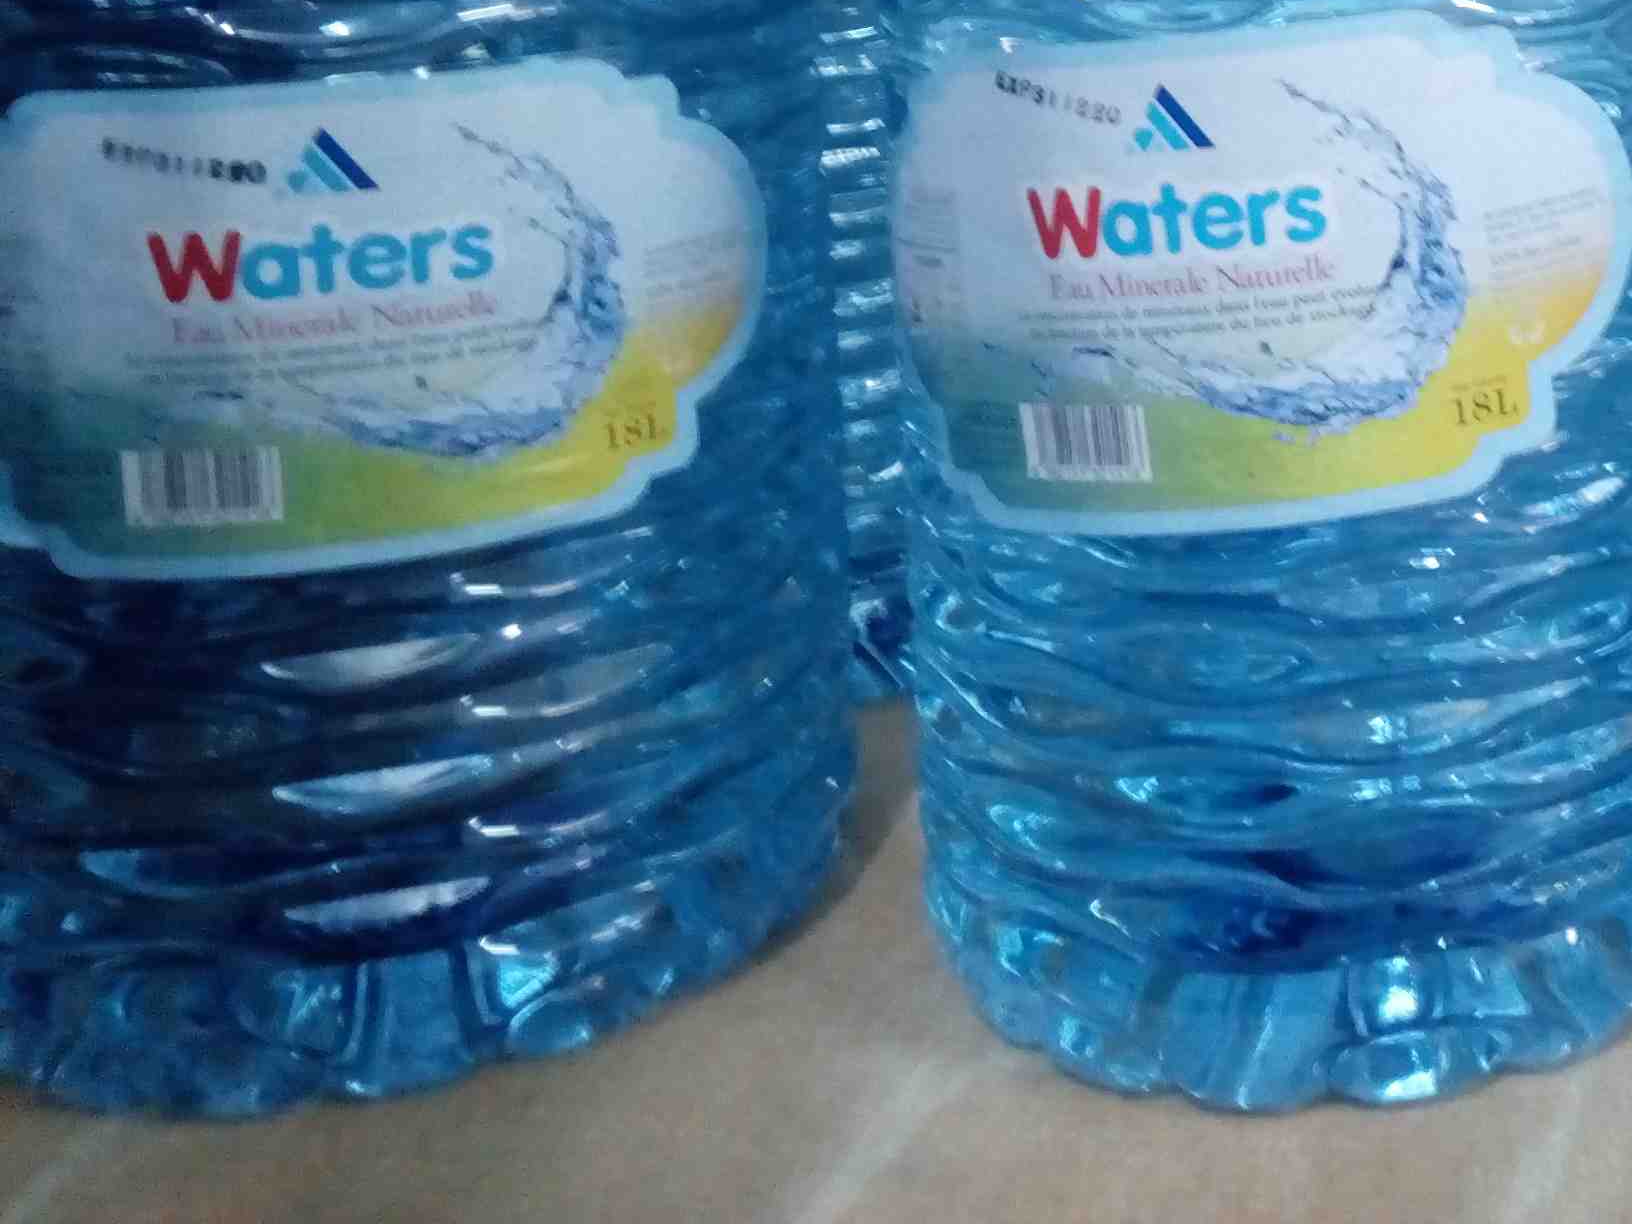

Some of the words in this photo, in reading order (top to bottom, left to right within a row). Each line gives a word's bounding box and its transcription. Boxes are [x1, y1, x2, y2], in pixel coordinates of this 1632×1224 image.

[1026, 182, 1327, 259] Waters
[146, 223, 494, 304] Waters
[1050, 272, 1094, 302] Eau
[1214, 254, 1337, 293] Naturelle
[603, 413, 668, 449] 18L
[1450, 388, 1519, 426] 18L
